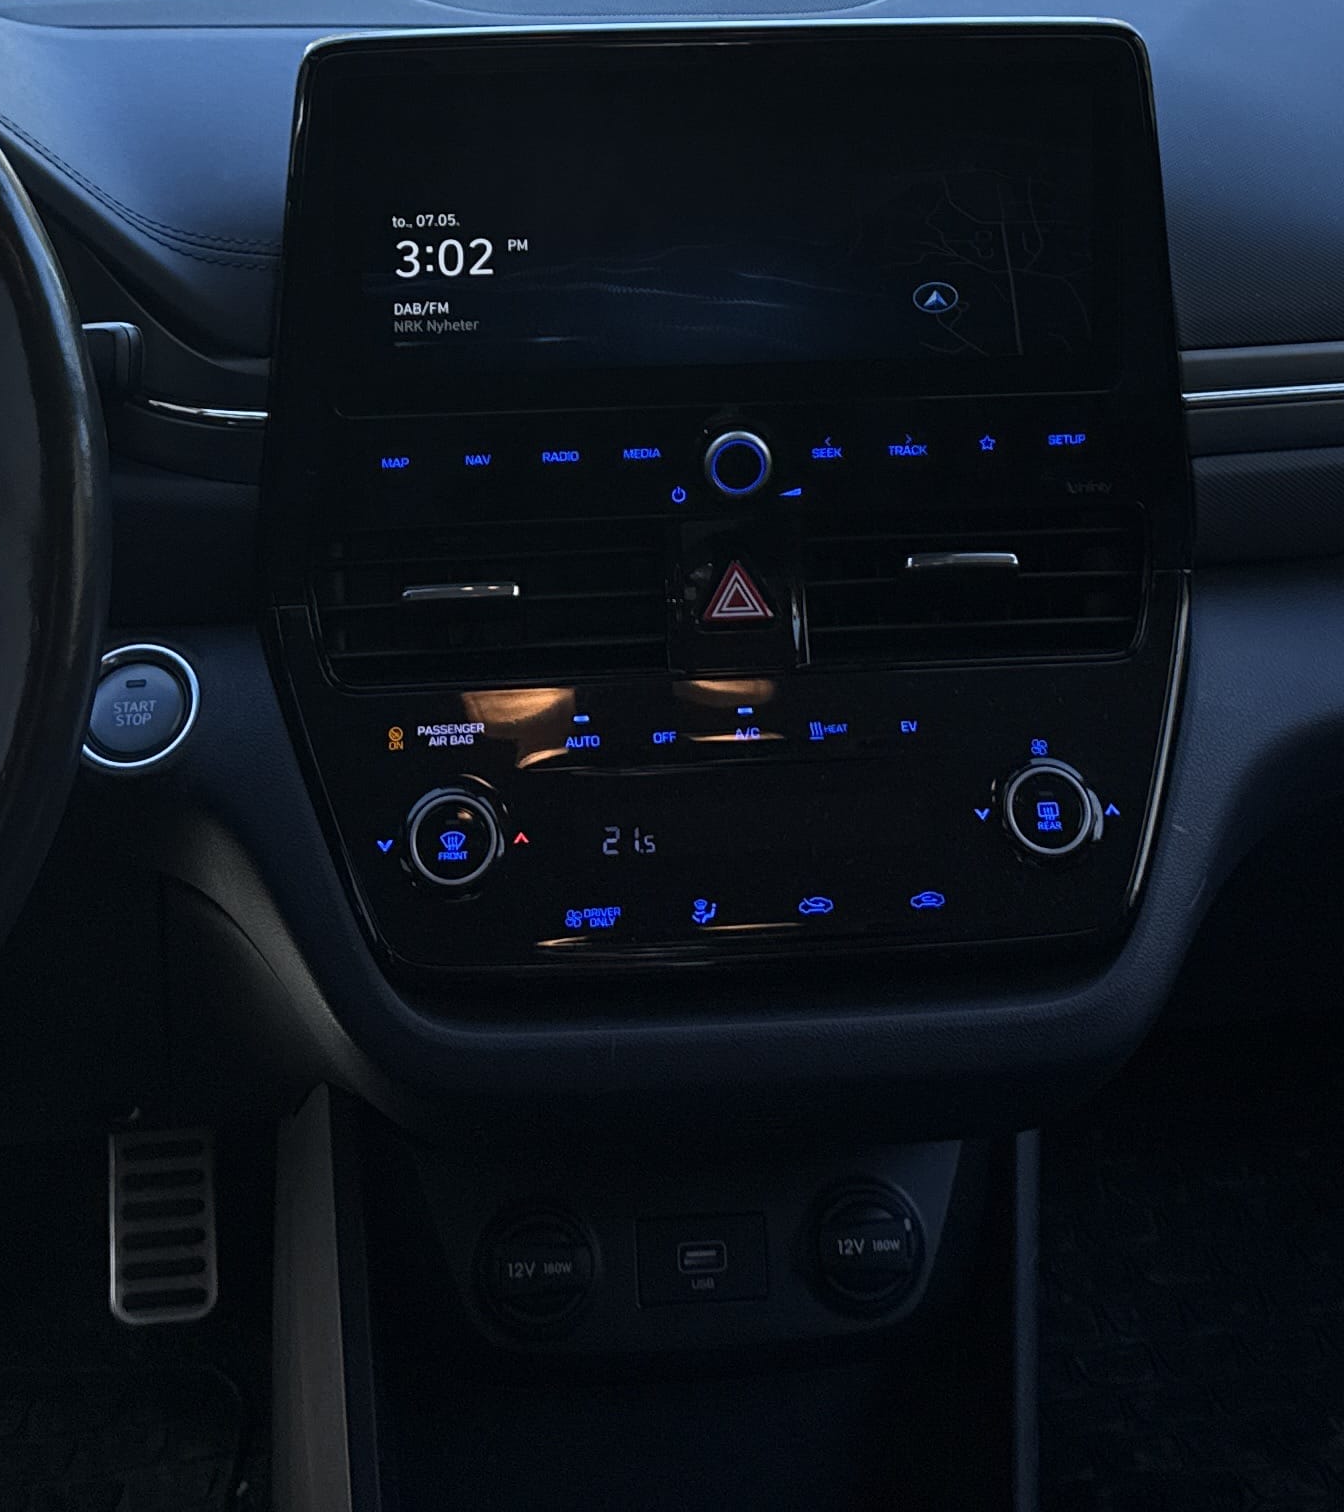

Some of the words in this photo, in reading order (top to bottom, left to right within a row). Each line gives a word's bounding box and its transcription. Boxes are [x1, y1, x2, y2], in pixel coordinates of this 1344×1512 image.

[415, 213, 461, 228] 07.05.
[394, 238, 495, 279] 3:02
[507, 238, 529, 252] PM
[393, 300, 450, 317] DAB/FM
[393, 318, 424, 334] NRK
[426, 318, 480, 335] Nyheter
[1047, 433, 1087, 448] SETUP
[540, 448, 581, 465] RADIO
[622, 446, 662, 461] MEDIA
[810, 446, 844, 460] SEEK
[887, 443, 929, 458] TRACK
[380, 456, 411, 471] MAP
[464, 452, 493, 468] NAV
[113, 699, 157, 714] START
[116, 712, 152, 727] STOP
[899, 719, 919, 735] EV
[416, 721, 486, 737] PASSENGER
[734, 726, 761, 741] A/C
[823, 721, 849, 736] HEAT
[428, 735, 448, 748] AIR
[449, 733, 475, 747] BAG
[564, 734, 602, 750] AUTO
[651, 730, 678, 745] OFF
[387, 739, 405, 753] ON
[1036, 820, 1063, 833] REAR
[436, 850, 470, 863] FRONT
[583, 905, 623, 920] DRIVER
[589, 916, 617, 929] ONLY
[837, 1237, 865, 1256] 12V
[508, 1261, 537, 1279] 12V
